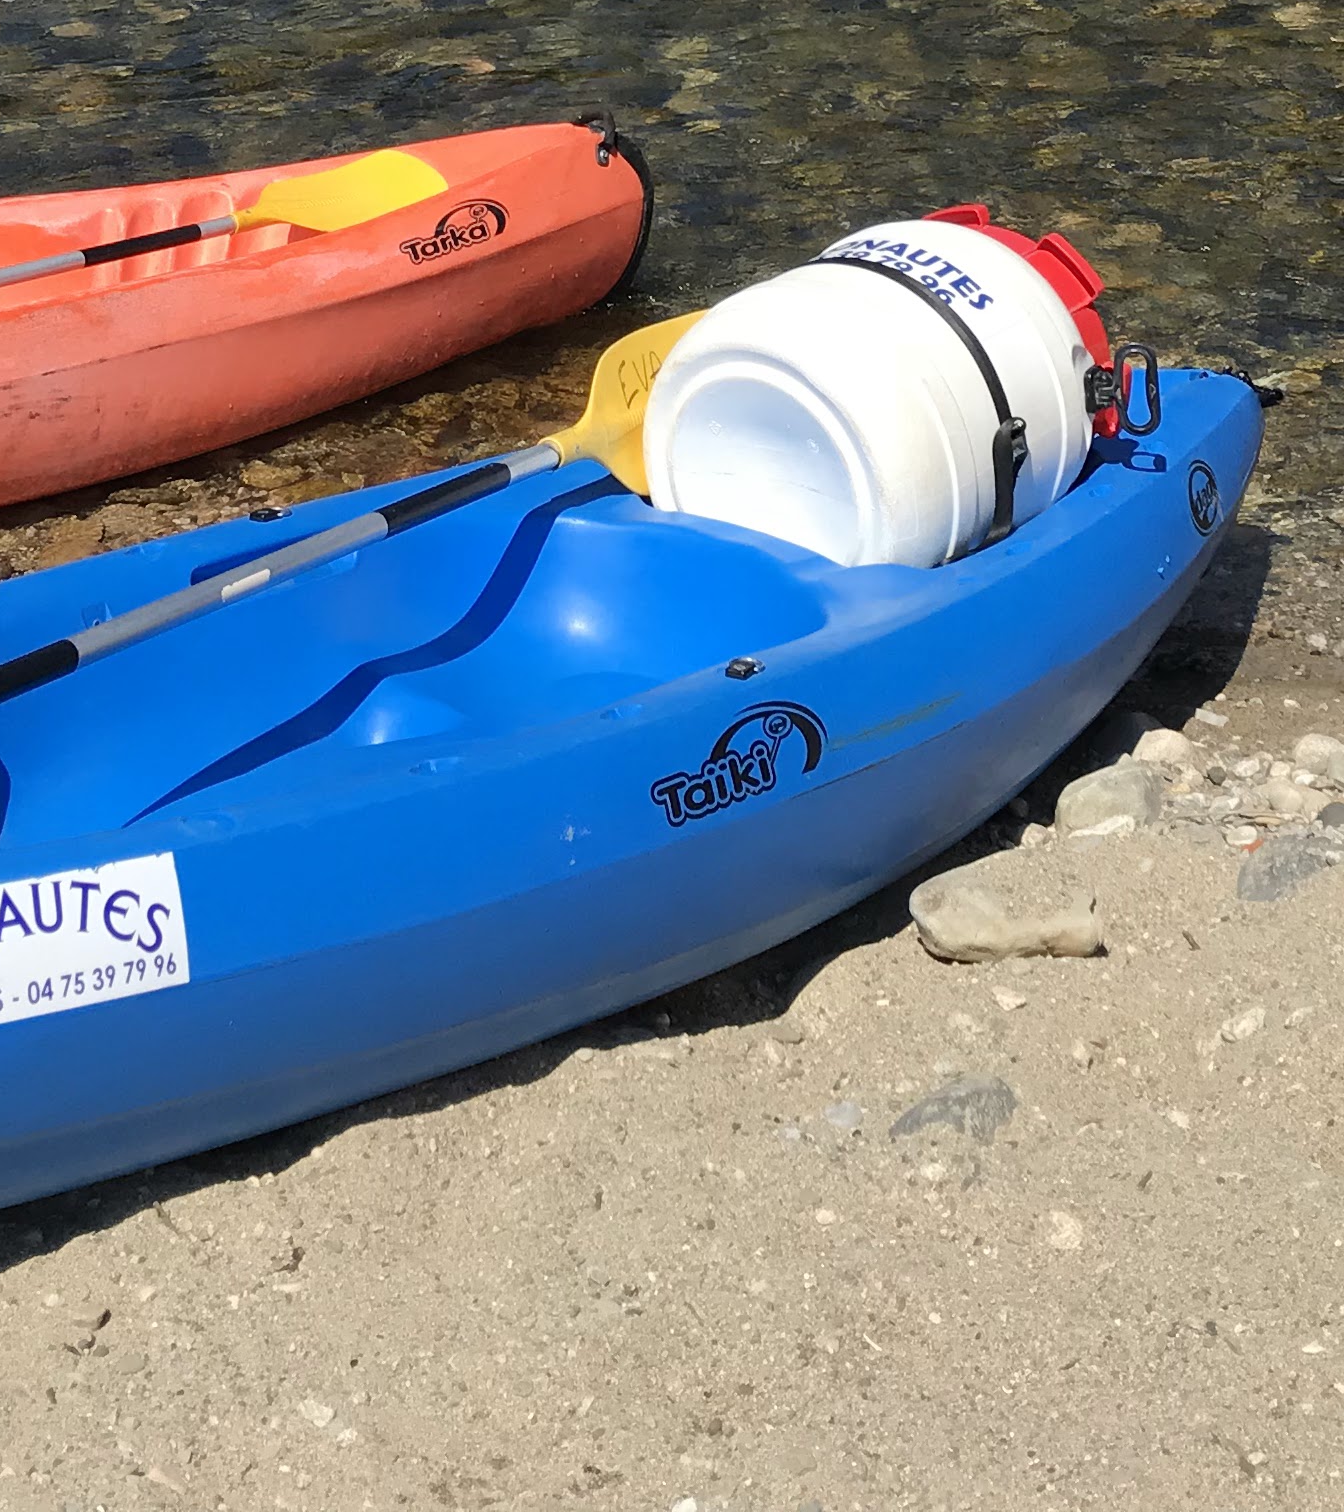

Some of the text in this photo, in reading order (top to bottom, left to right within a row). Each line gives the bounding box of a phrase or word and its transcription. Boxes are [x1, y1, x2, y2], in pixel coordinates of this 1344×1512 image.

[401, 222, 490, 264] Tarka
[920, 275, 956, 305] 96
[652, 742, 776, 826] Taïki
[28, 978, 54, 1004] 04
[60, 972, 86, 998] 75
[92, 965, 116, 991] 39
[123, 958, 146, 984] 79
[154, 952, 177, 978] 96
